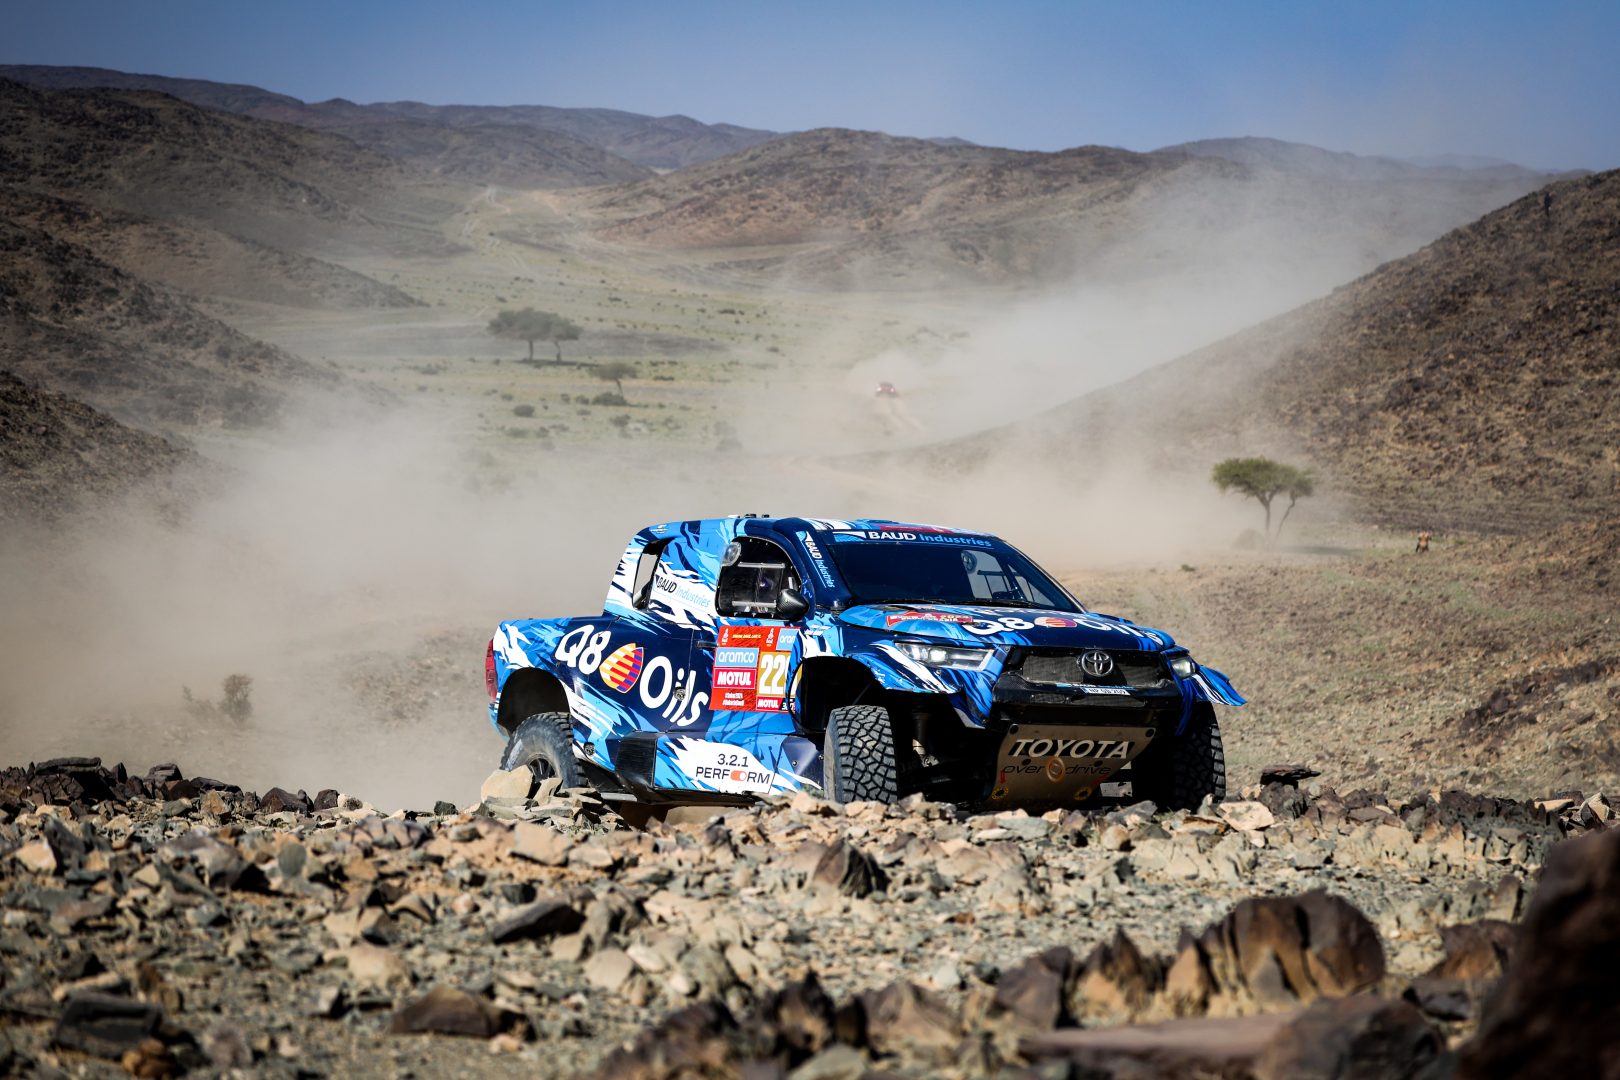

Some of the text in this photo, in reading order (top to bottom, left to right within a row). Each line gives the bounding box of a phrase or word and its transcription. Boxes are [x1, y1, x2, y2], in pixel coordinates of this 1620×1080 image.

[869, 531, 992, 547] BAUD Industries
[805, 540, 836, 588] BAUD Industries
[656, 576, 712, 608] BAUD Industries
[962, 616, 1035, 635] Q8
[718, 650, 755, 664] aramco
[554, 624, 710, 727] Q8 Oils
[717, 671, 752, 686] MOTUL
[757, 698, 779, 709] MOTUL
[1010, 738, 1131, 759] TOYOTA
[717, 753, 749, 768] 3.2.1
[1003, 763, 1112, 775] over drive
